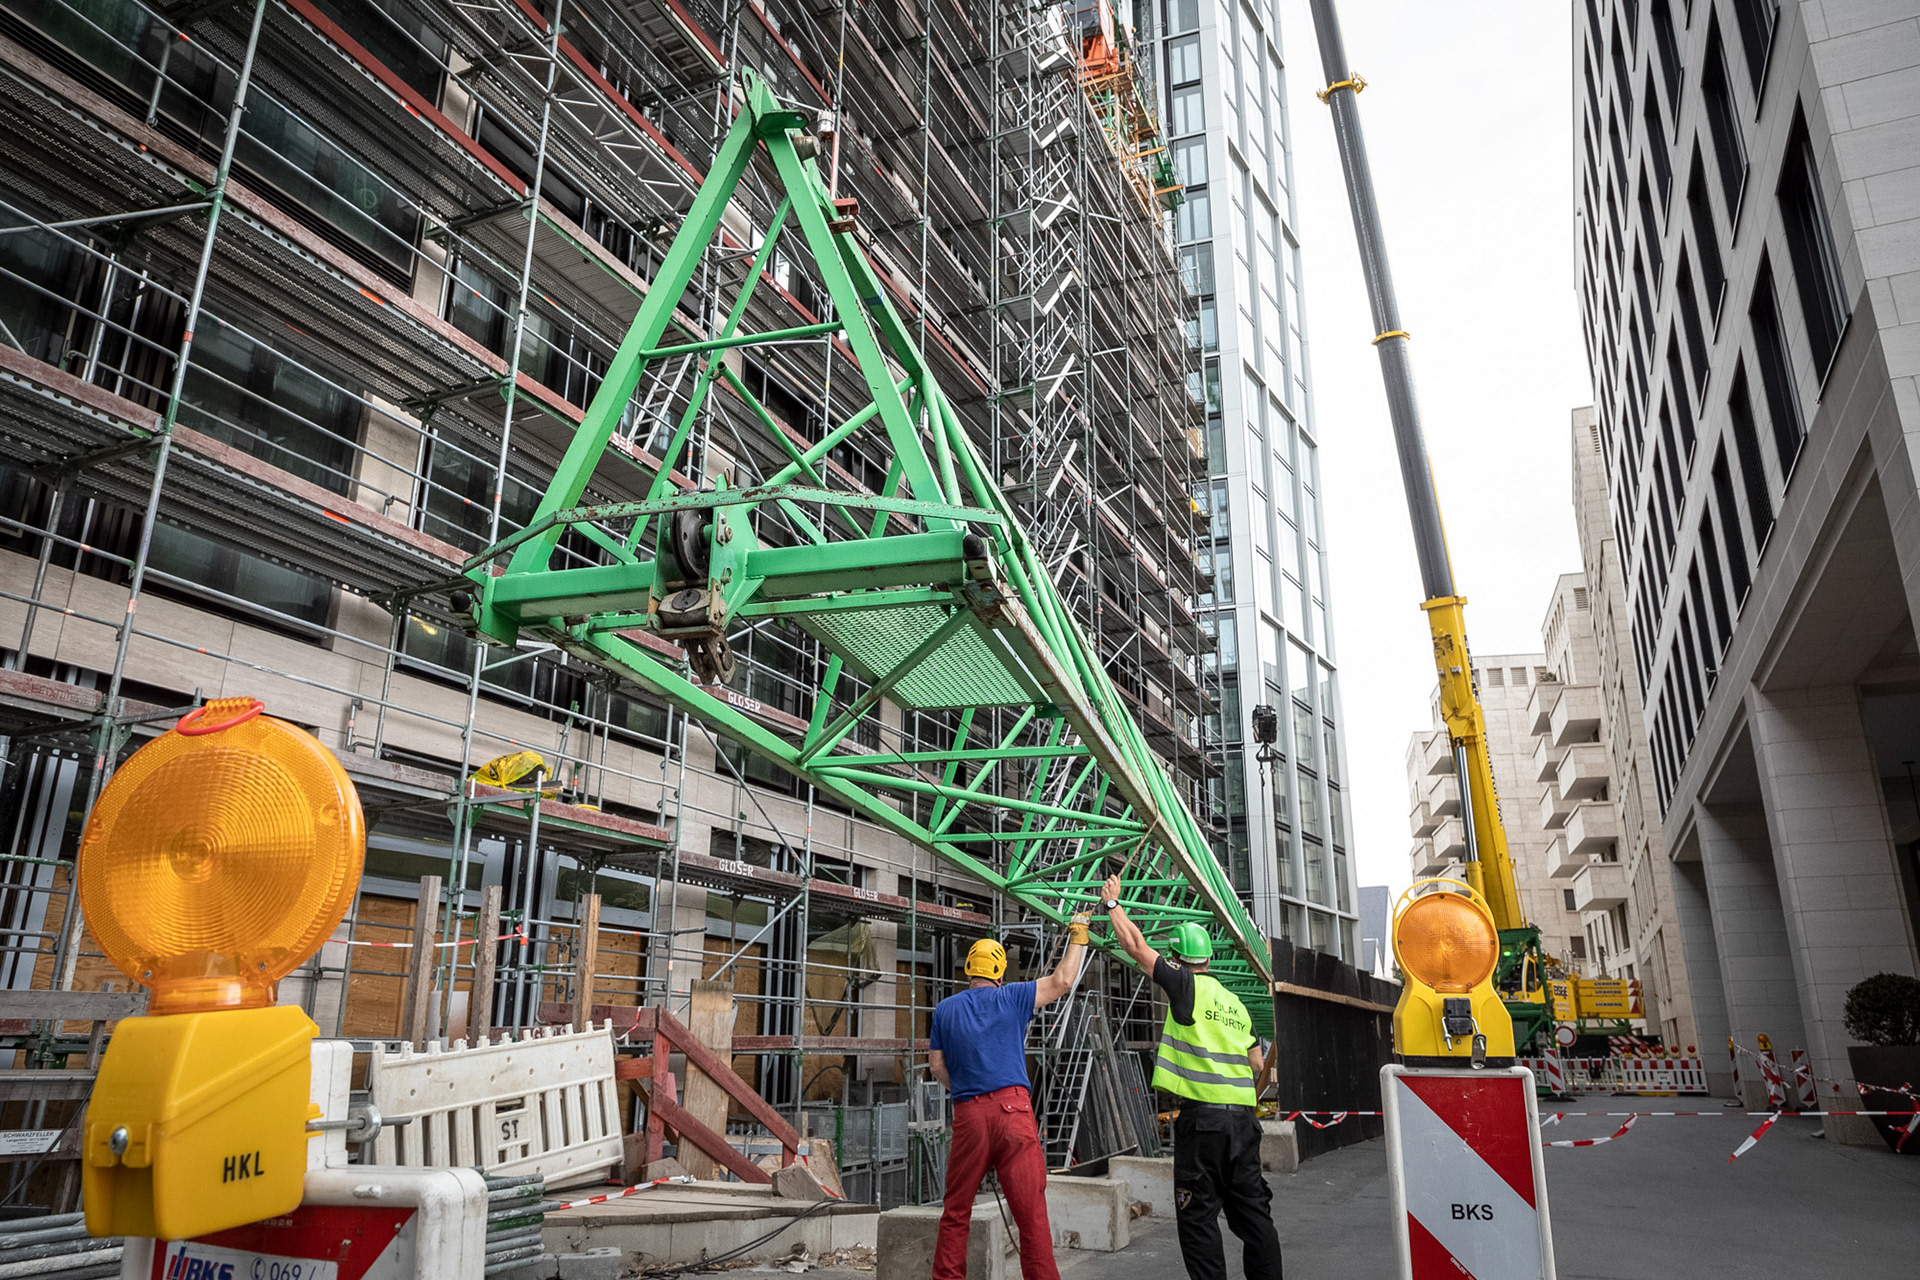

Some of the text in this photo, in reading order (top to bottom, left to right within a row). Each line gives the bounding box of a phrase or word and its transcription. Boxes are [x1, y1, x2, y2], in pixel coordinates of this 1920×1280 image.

[727, 691, 761, 714] GLOSER
[719, 859, 754, 877] GLOSER
[853, 887, 879, 901] GLOSER
[3, 1131, 54, 1139] SCHWARZFELLER
[501, 1119, 519, 1141] ST
[223, 1151, 265, 1184] HKL
[1451, 1203, 1494, 1221] BKS
